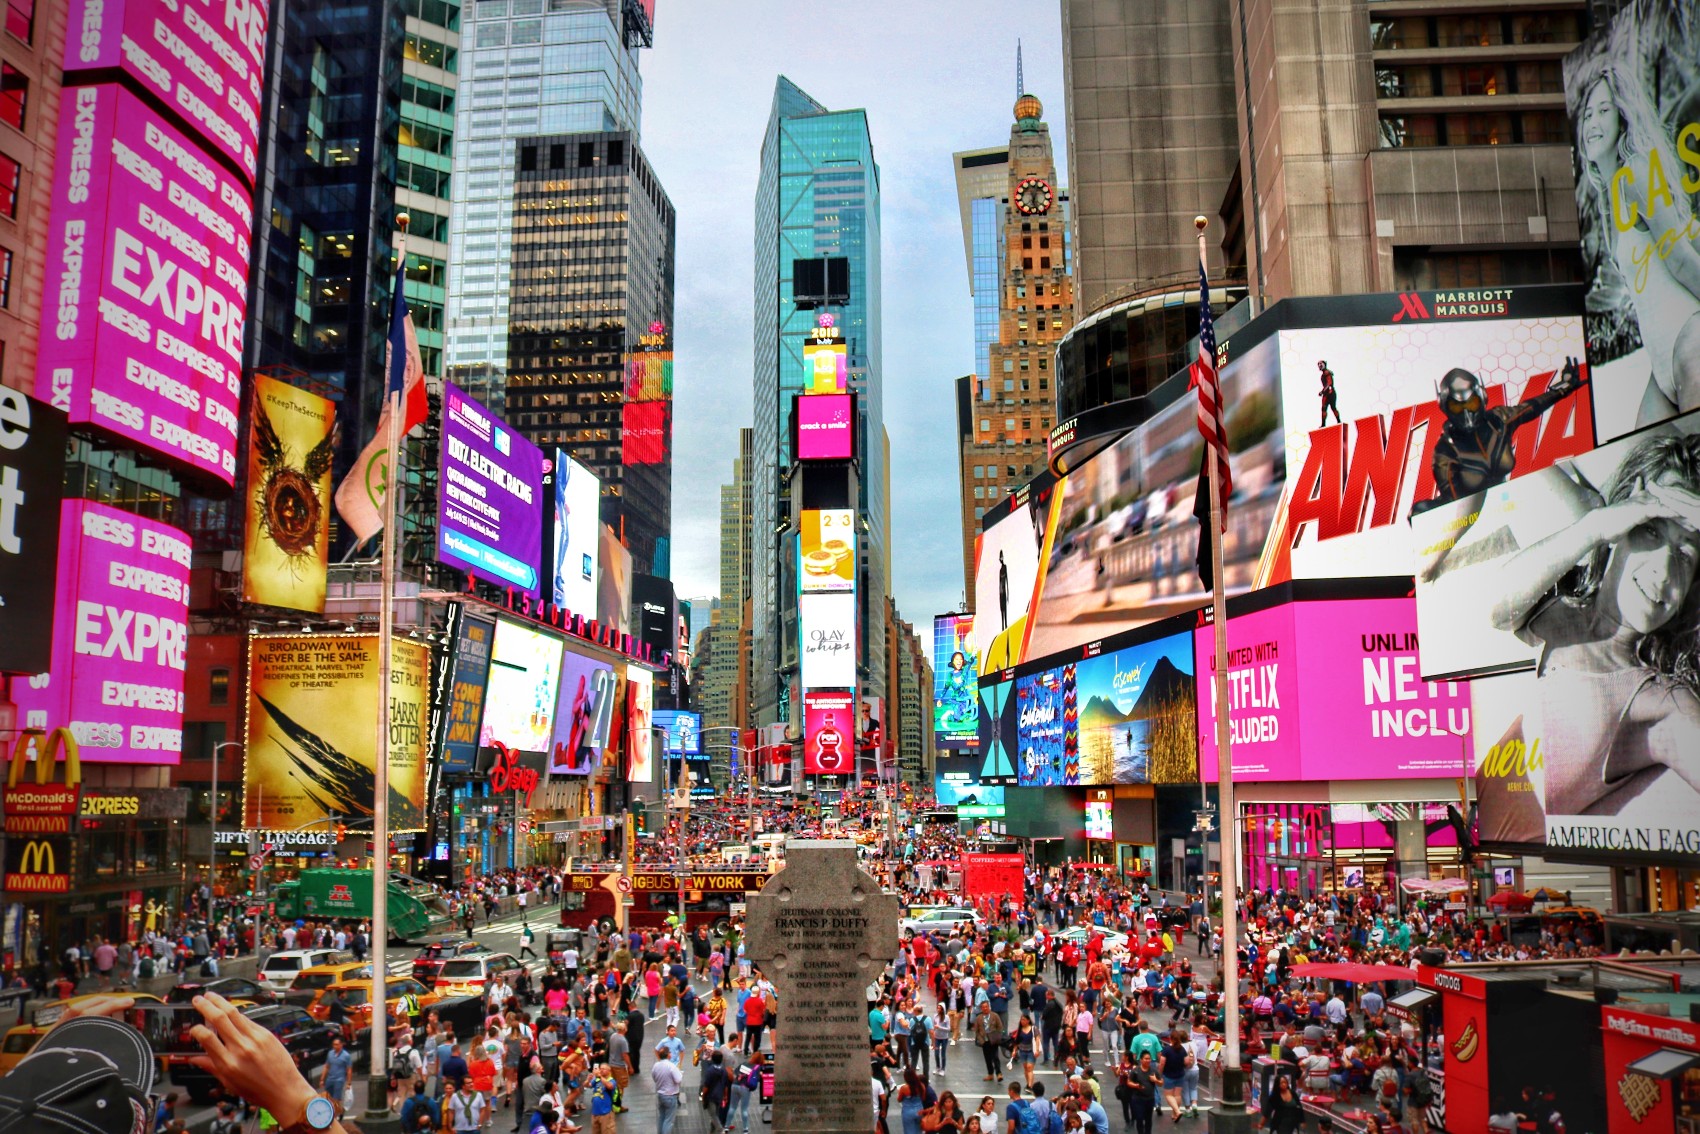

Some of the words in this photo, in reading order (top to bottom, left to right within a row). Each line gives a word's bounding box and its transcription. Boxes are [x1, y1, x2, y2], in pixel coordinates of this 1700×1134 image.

[183, 4, 248, 80] EXPRESS
[154, 18, 224, 96] EXPRESS
[176, 82, 242, 153] EXPRESS
[68, 87, 97, 204] EXPRESS
[145, 121, 216, 192] EXPRESS
[168, 180, 235, 245] EXPRESS
[138, 202, 211, 268] EXPRESS
[56, 220, 86, 341] EXPRESS
[112, 228, 243, 363] EXPRE
[1435, 290, 1513, 303] MARRIOTT
[1437, 303, 1505, 316] MARQUIS
[811, 327, 839, 338] 2018
[156, 329, 225, 384] EXPRESS
[126, 357, 200, 412] EXPRESS
[266, 393, 328, 423] #KeepTheSecrets
[150, 415, 220, 464] EXPRESS
[800, 422, 820, 430] crack
[828, 421, 847, 430] smile
[1051, 418, 1078, 440] MARRIOTT
[823, 515, 832, 527] 2
[109, 561, 182, 602] EXPRESS
[75, 600, 187, 671] EXPRE
[506, 586, 558, 626] 1540
[562, 608, 653, 662] BROADWAY
[810, 629, 846, 642] OLAY
[258, 653, 294, 663] NEVER
[297, 653, 310, 663] BE
[314, 653, 335, 662] THE
[338, 652, 371, 662] SAME.
[335, 641, 363, 650] WILL
[806, 635, 851, 657] whips
[1210, 647, 1253, 671] UMITED
[1255, 641, 1279, 662] WITH
[317, 672, 364, 680] POSSIBILITIES
[343, 663, 364, 671] THAT
[406, 672, 422, 687] PLAY
[102, 680, 176, 712] EXPRESS
[454, 681, 482, 701] COME
[1210, 663, 1280, 718] NTFLIX
[390, 696, 421, 725] HARRY
[584, 668, 618, 749] 21
[1372, 708, 1470, 738] INCLU
[448, 722, 478, 743] AWAY
[1214, 715, 1279, 746] ICLUDED
[6, 793, 74, 804] McDonald's
[81, 796, 139, 815] EXPRESS
[214, 832, 250, 844] GIFTS
[265, 833, 338, 845] LUGGAGE
[1550, 826, 1651, 850] AMERICAN
[632, 876, 671, 889] IGBUS
[675, 877, 705, 889] NW
[708, 876, 744, 889] YORK
[775, 918, 819, 928] FRANCIS
[832, 918, 869, 928] DUFFY
[781, 908, 825, 916] LIEUTENANT
[826, 908, 861, 916] COLONEL
